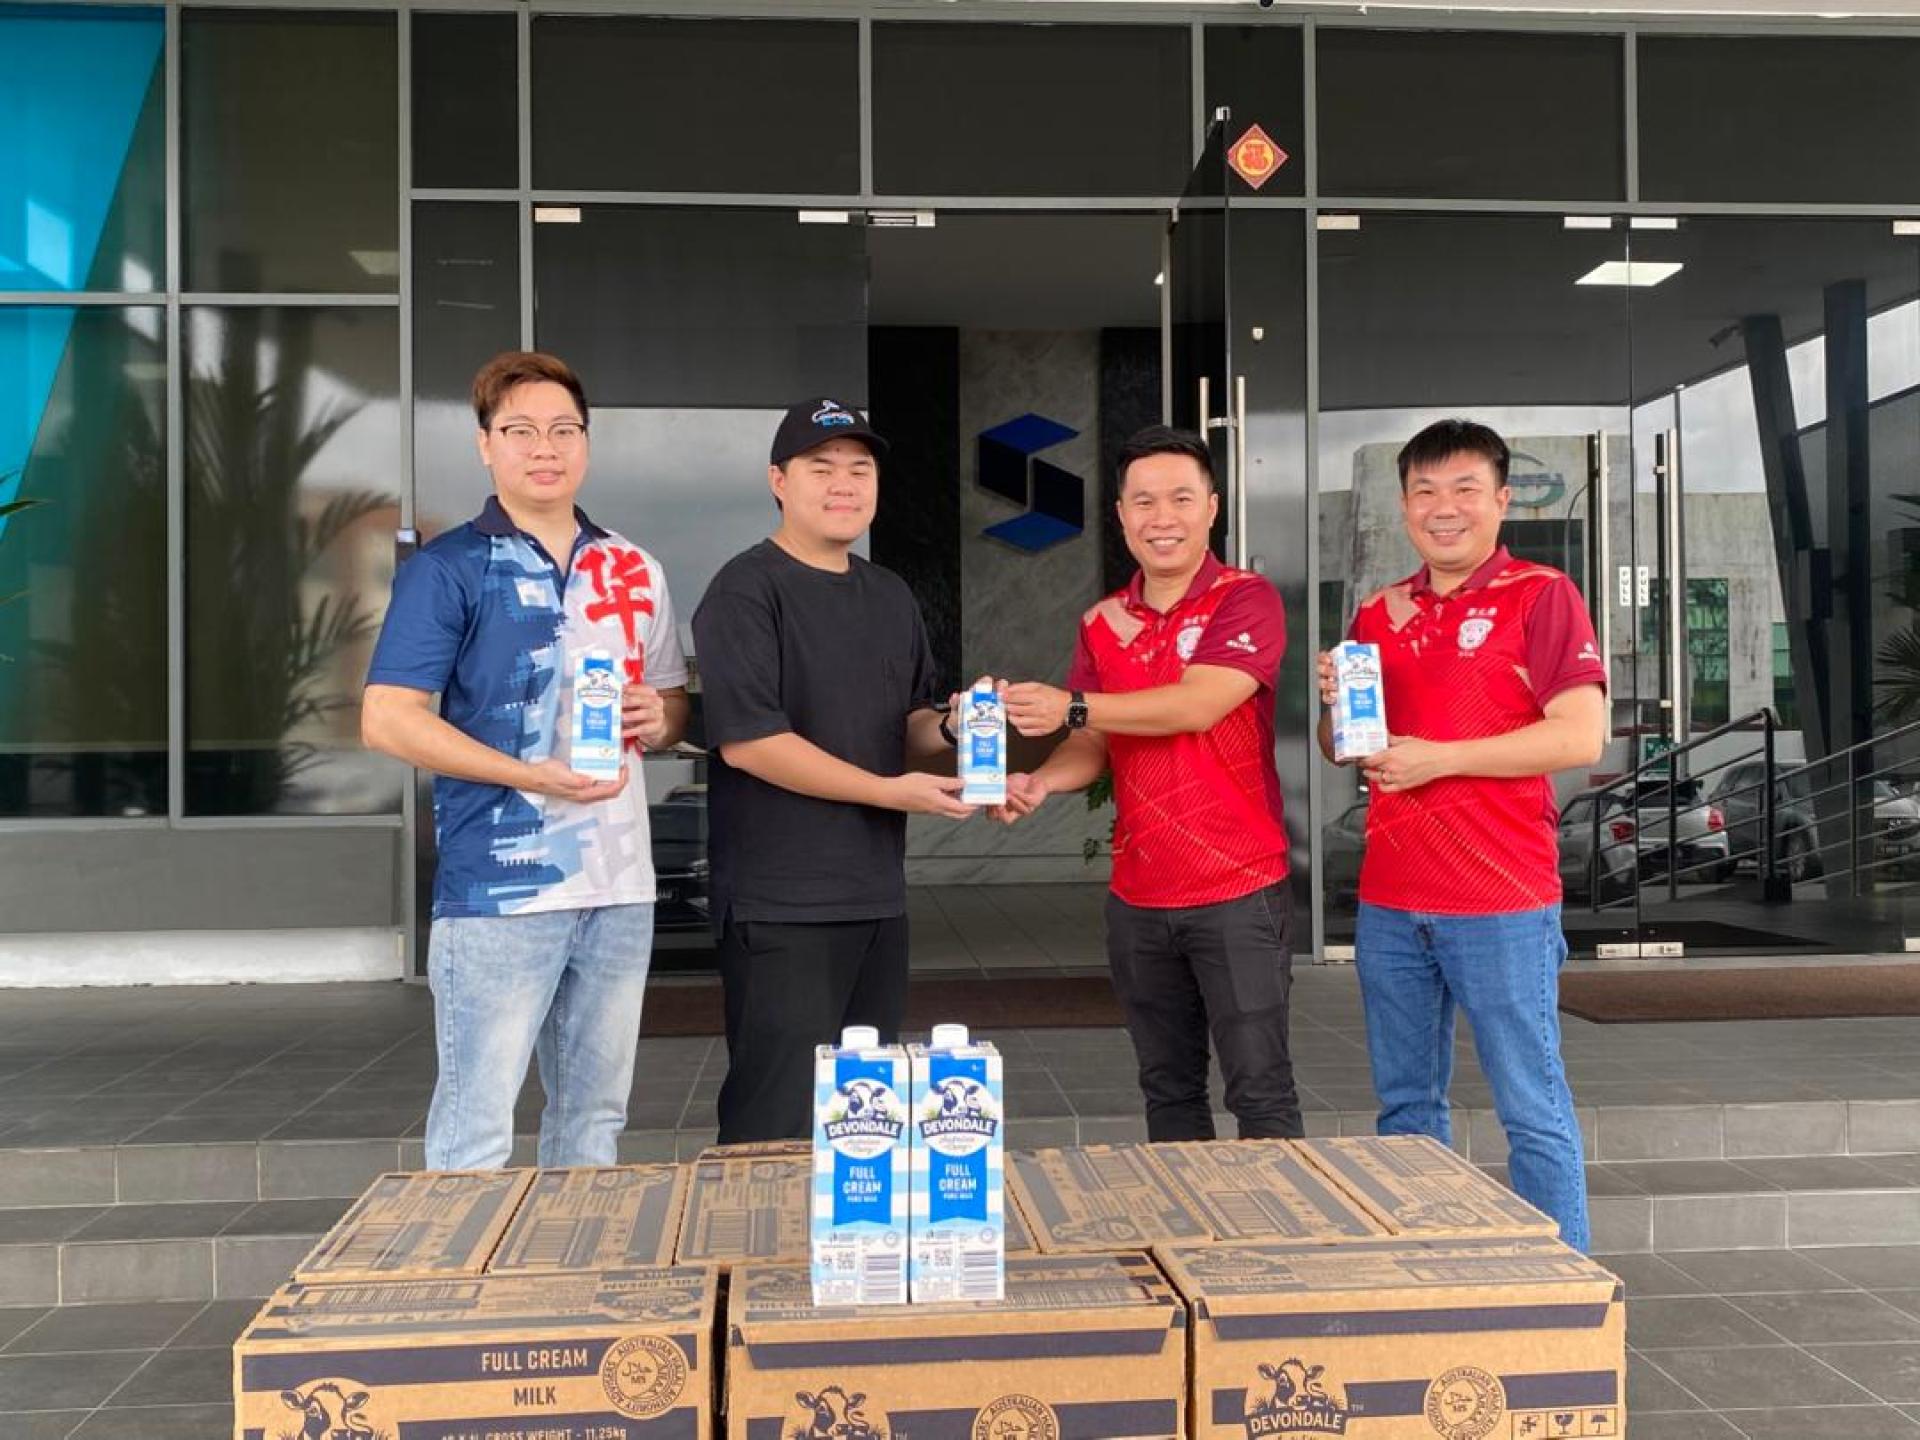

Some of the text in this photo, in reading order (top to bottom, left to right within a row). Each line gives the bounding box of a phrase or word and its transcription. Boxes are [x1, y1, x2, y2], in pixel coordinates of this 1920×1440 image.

[576, 547, 654, 648] 华
[828, 1120, 898, 1137] DEVONDALE
[922, 1118, 993, 1135] DEVONDALE
[849, 1166, 875, 1180] FULL
[945, 1163, 971, 1178] FULL
[842, 1180, 882, 1194] CREAM
[938, 1177, 977, 1191] CREAM
[481, 1347, 588, 1373] FULL CREAM
[513, 1386, 557, 1407] MILK
[1250, 1411, 1342, 1434] DEVONDALE
[526, 1429, 572, 1440] WEIGHT
